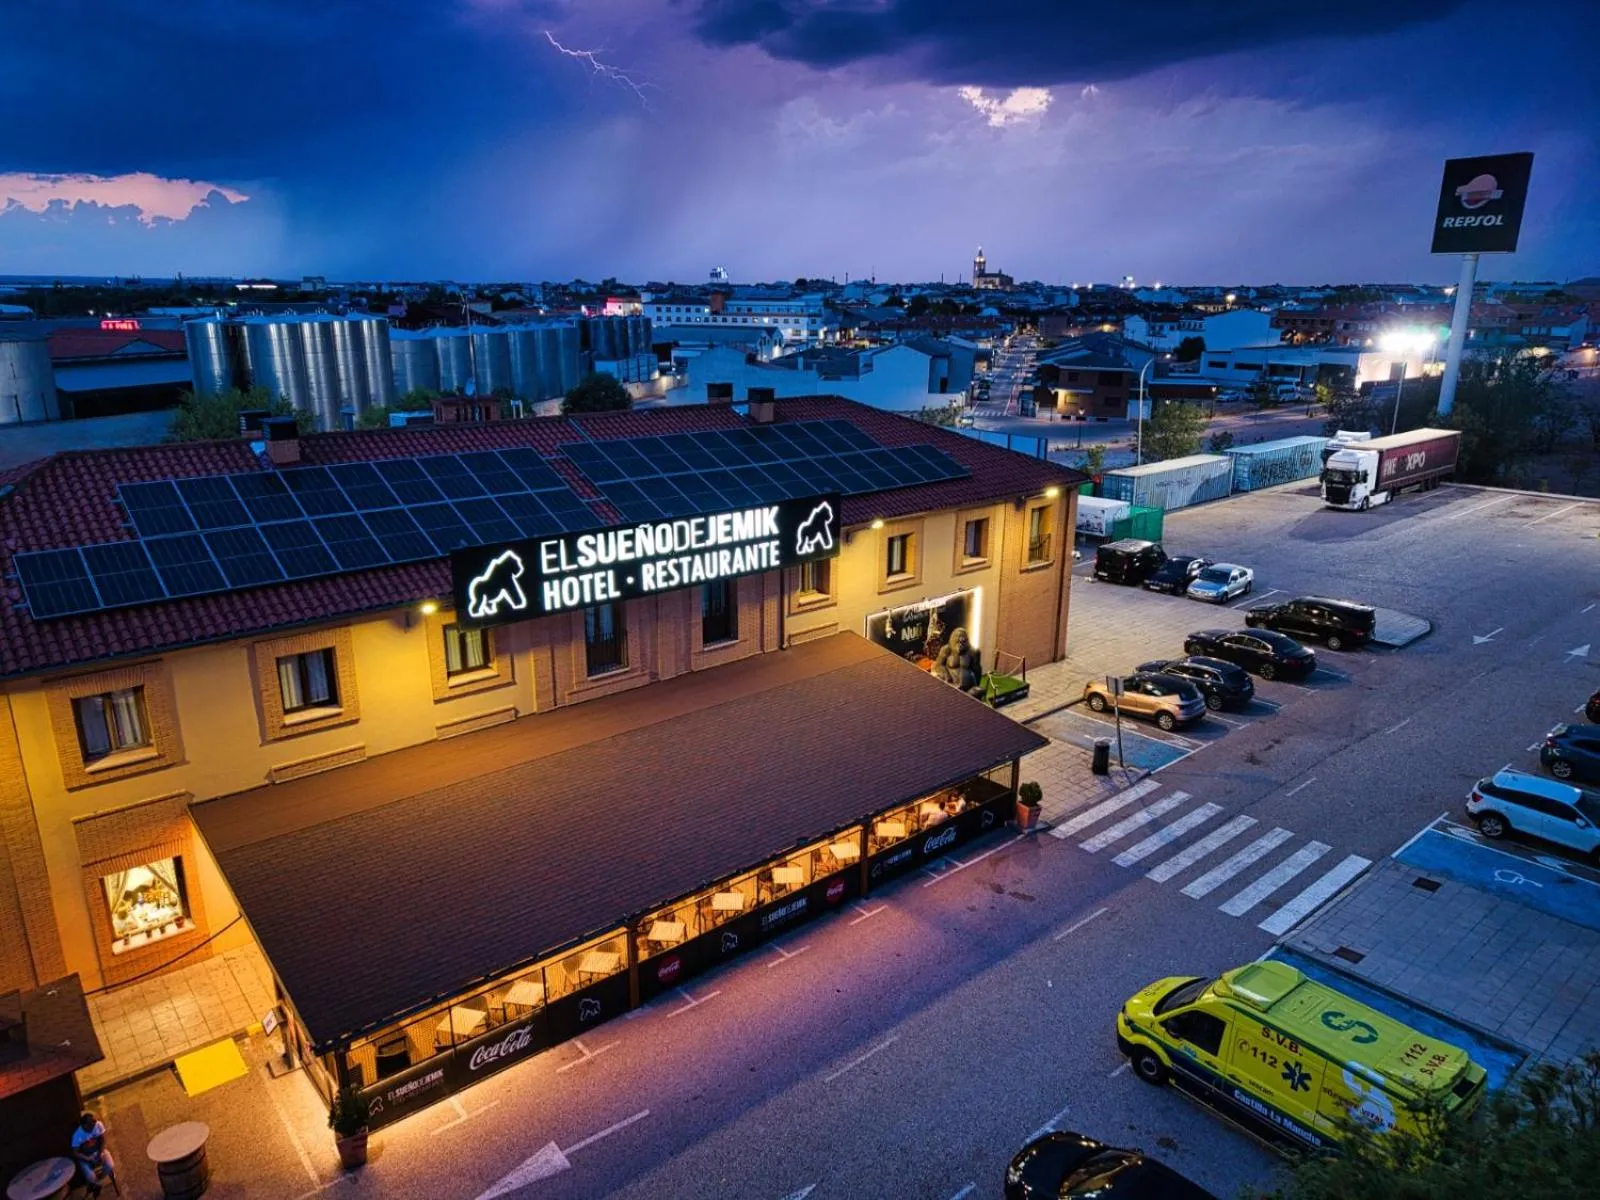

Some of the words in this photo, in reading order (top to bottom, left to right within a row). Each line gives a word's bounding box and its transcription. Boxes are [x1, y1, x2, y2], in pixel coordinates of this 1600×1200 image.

[1443, 214, 1504, 228] REPSOL
[1406, 451, 1426, 471] XPO
[543, 570, 621, 611] HOTEL
[642, 540, 780, 592] RESTAURANTE
[469, 1024, 535, 1071] Coca-Cola
[1261, 1026, 1304, 1057] S.V.B.
[1404, 1042, 1429, 1060] 112
[1251, 1045, 1278, 1069] 112
[1419, 1053, 1449, 1076] S.V.B.
